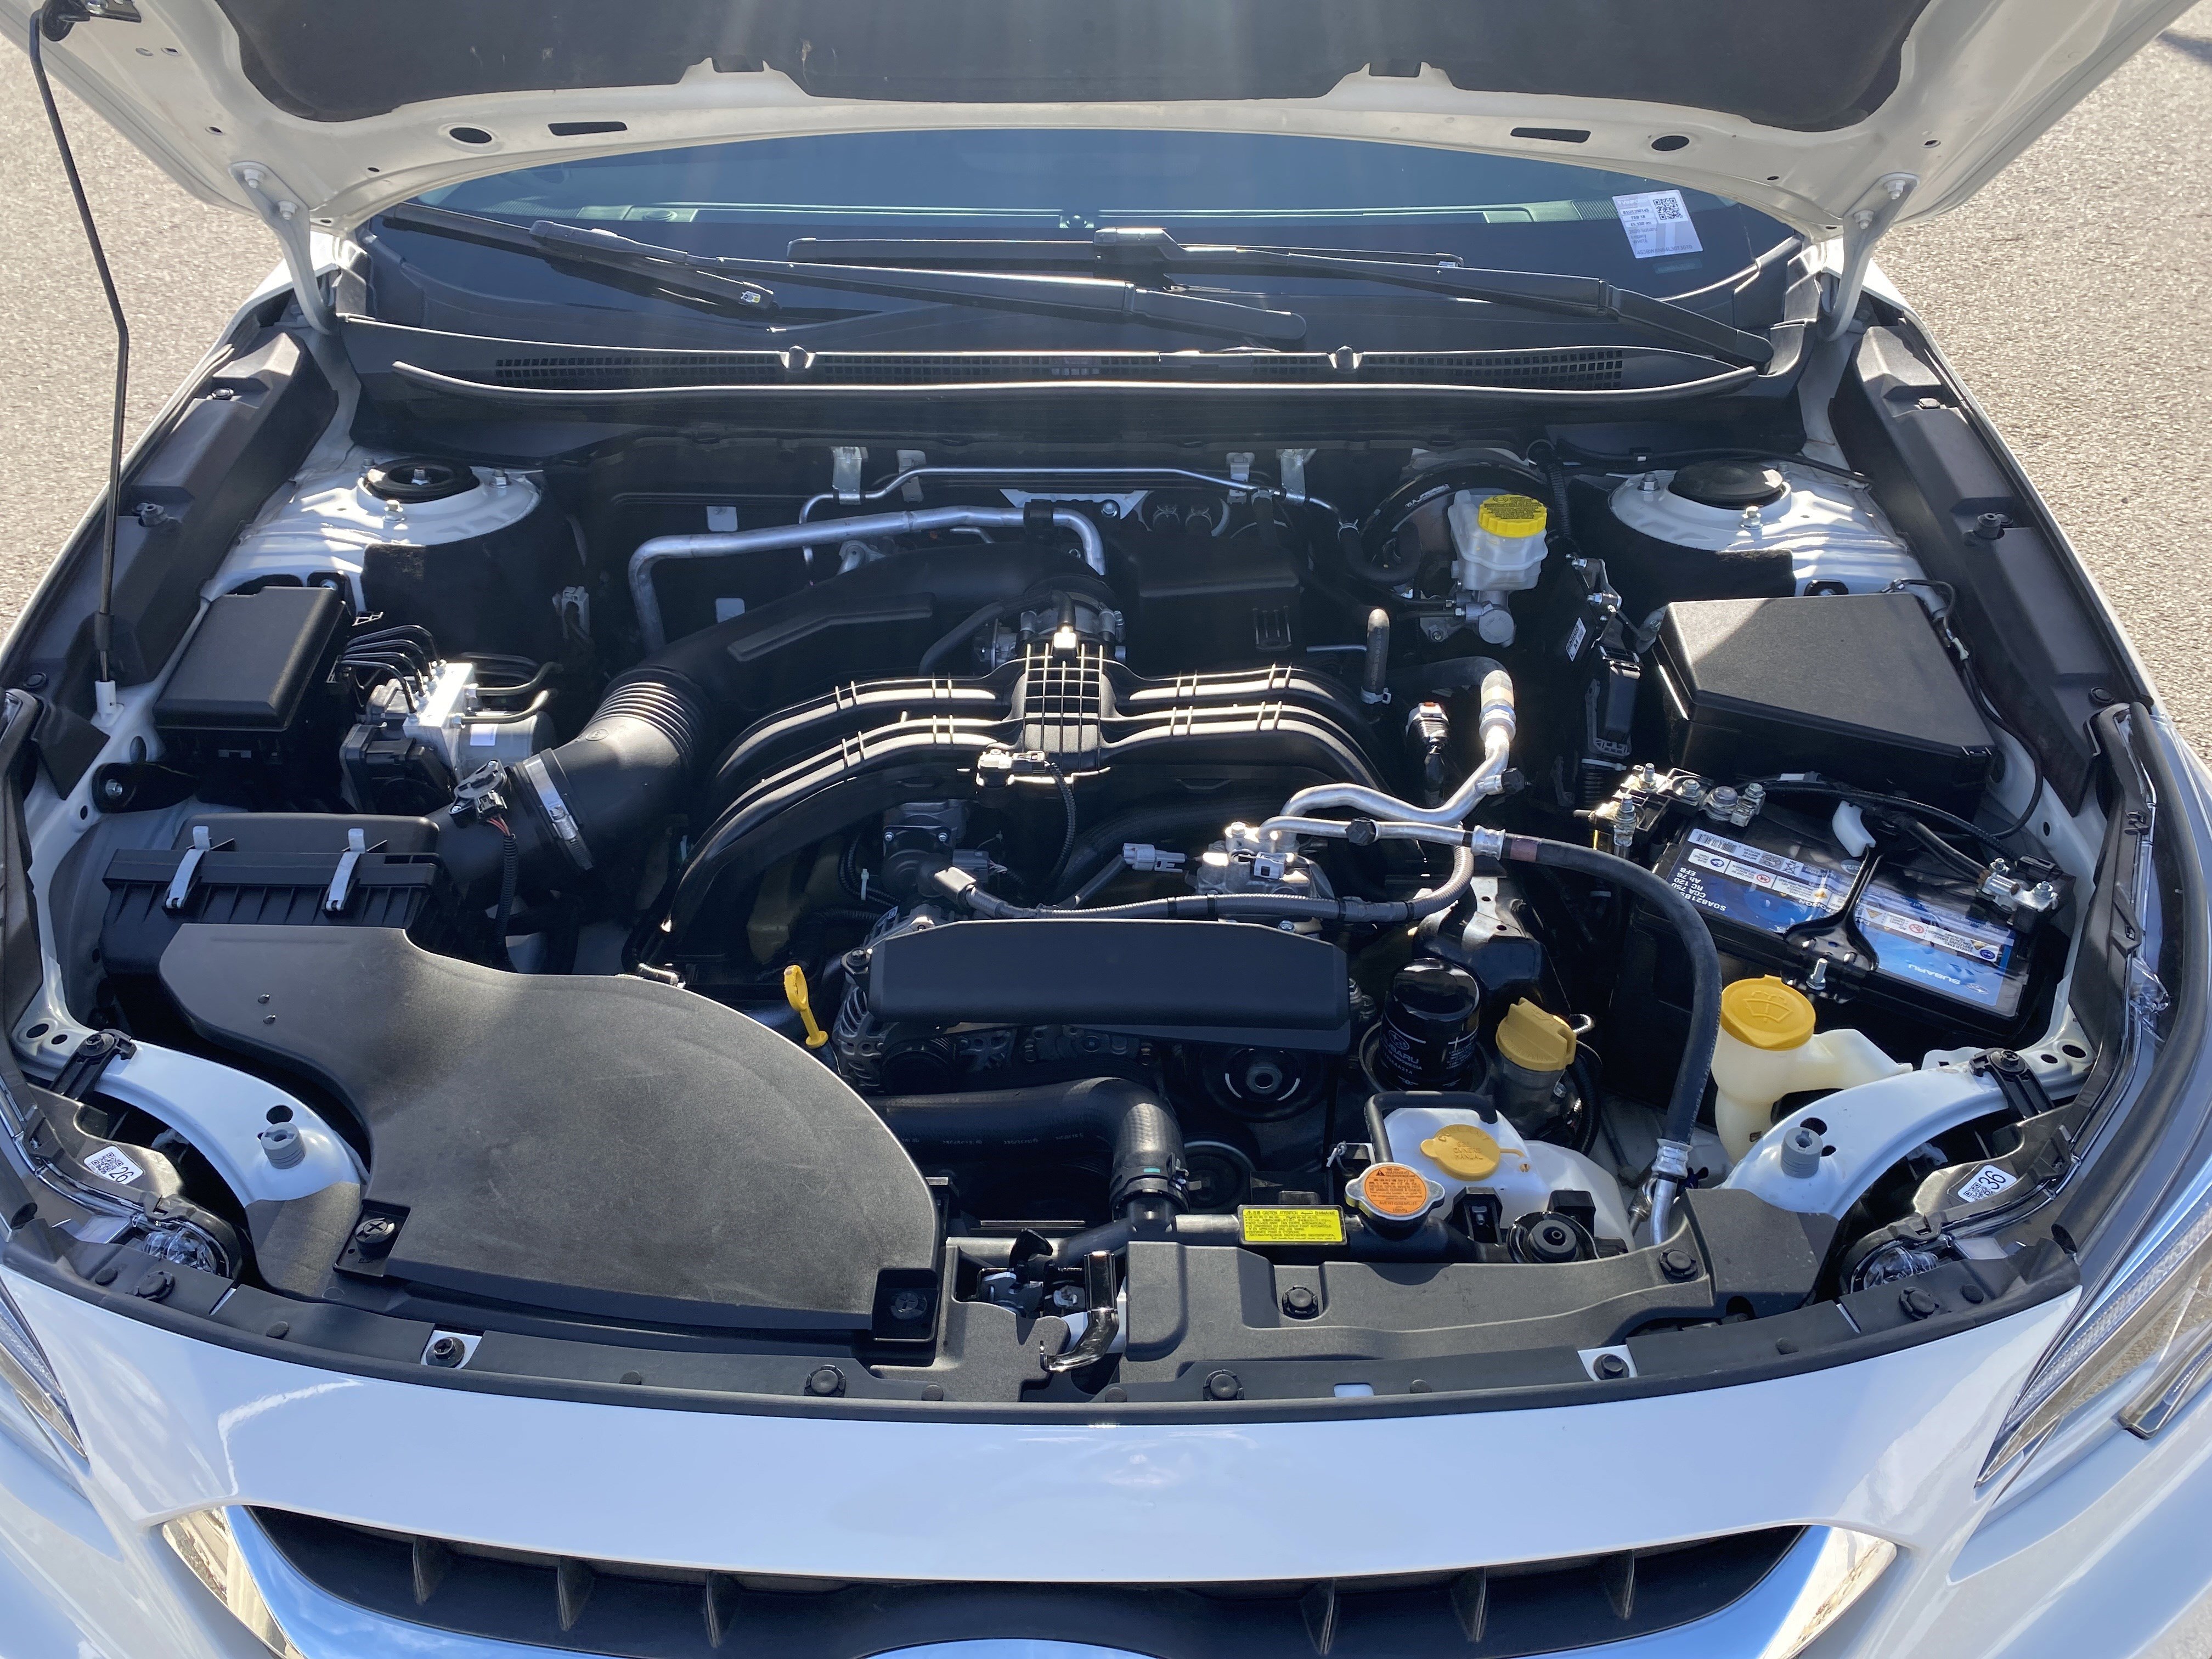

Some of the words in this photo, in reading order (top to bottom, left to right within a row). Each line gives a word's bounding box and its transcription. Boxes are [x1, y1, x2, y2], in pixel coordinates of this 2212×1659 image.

[1677, 872, 1688, 880] 76
[1679, 867, 1696, 877] EFB
[1671, 882, 1687, 892] 750
[1673, 877, 1689, 887] 120
[1691, 883, 1704, 891] RC
[1689, 888, 1706, 898] CCA
[1908, 963, 1961, 986] SUBARU
[109, 1166, 134, 1183] 26
[1978, 1171, 2006, 1190] 36
